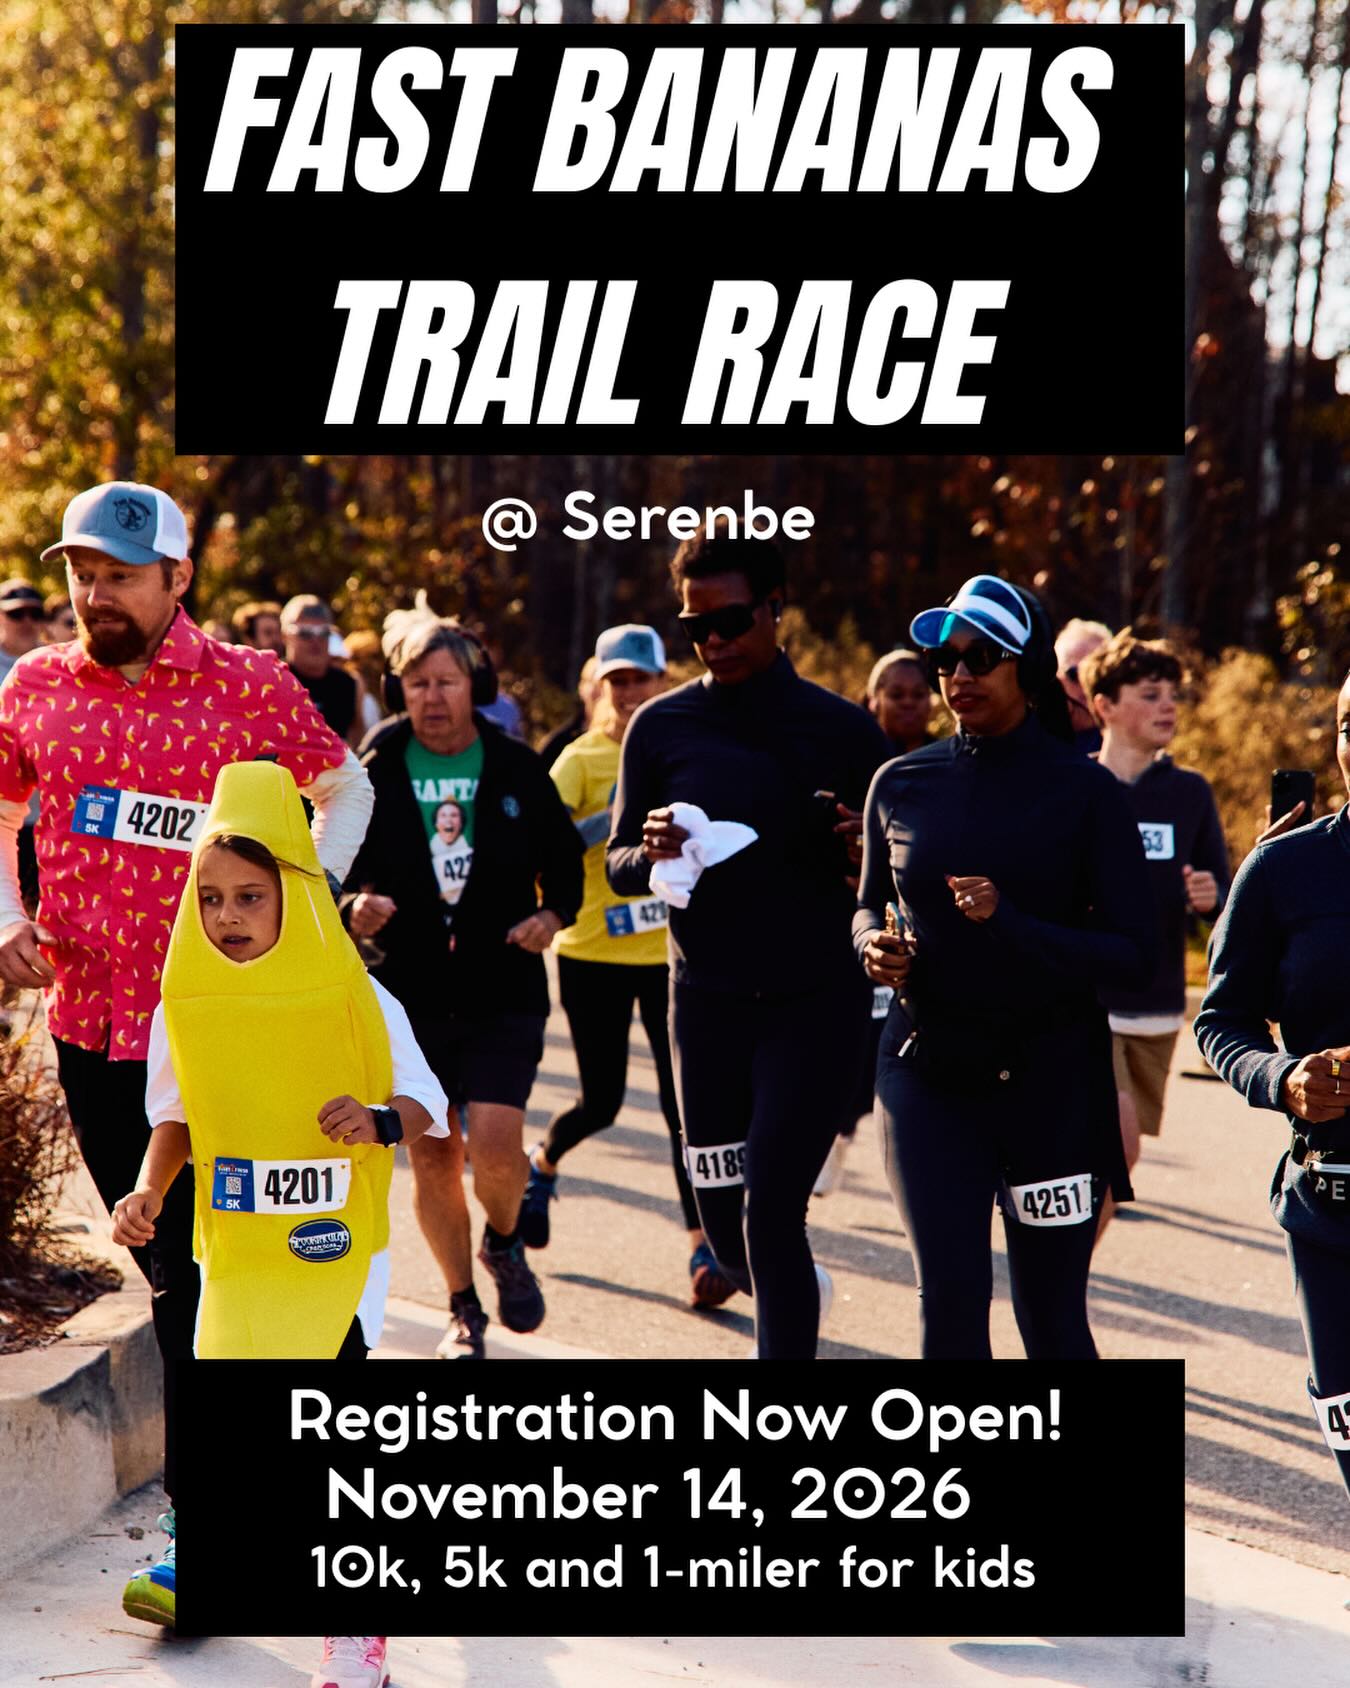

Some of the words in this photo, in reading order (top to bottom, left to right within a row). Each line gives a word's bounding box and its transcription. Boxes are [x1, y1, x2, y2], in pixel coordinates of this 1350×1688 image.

[85, 823, 100, 835] 5K
[127, 801, 196, 842] 4202
[226, 1199, 241, 1209] 5K
[264, 1166, 333, 1205] 4201
[1023, 1182, 1082, 1219] 4251
